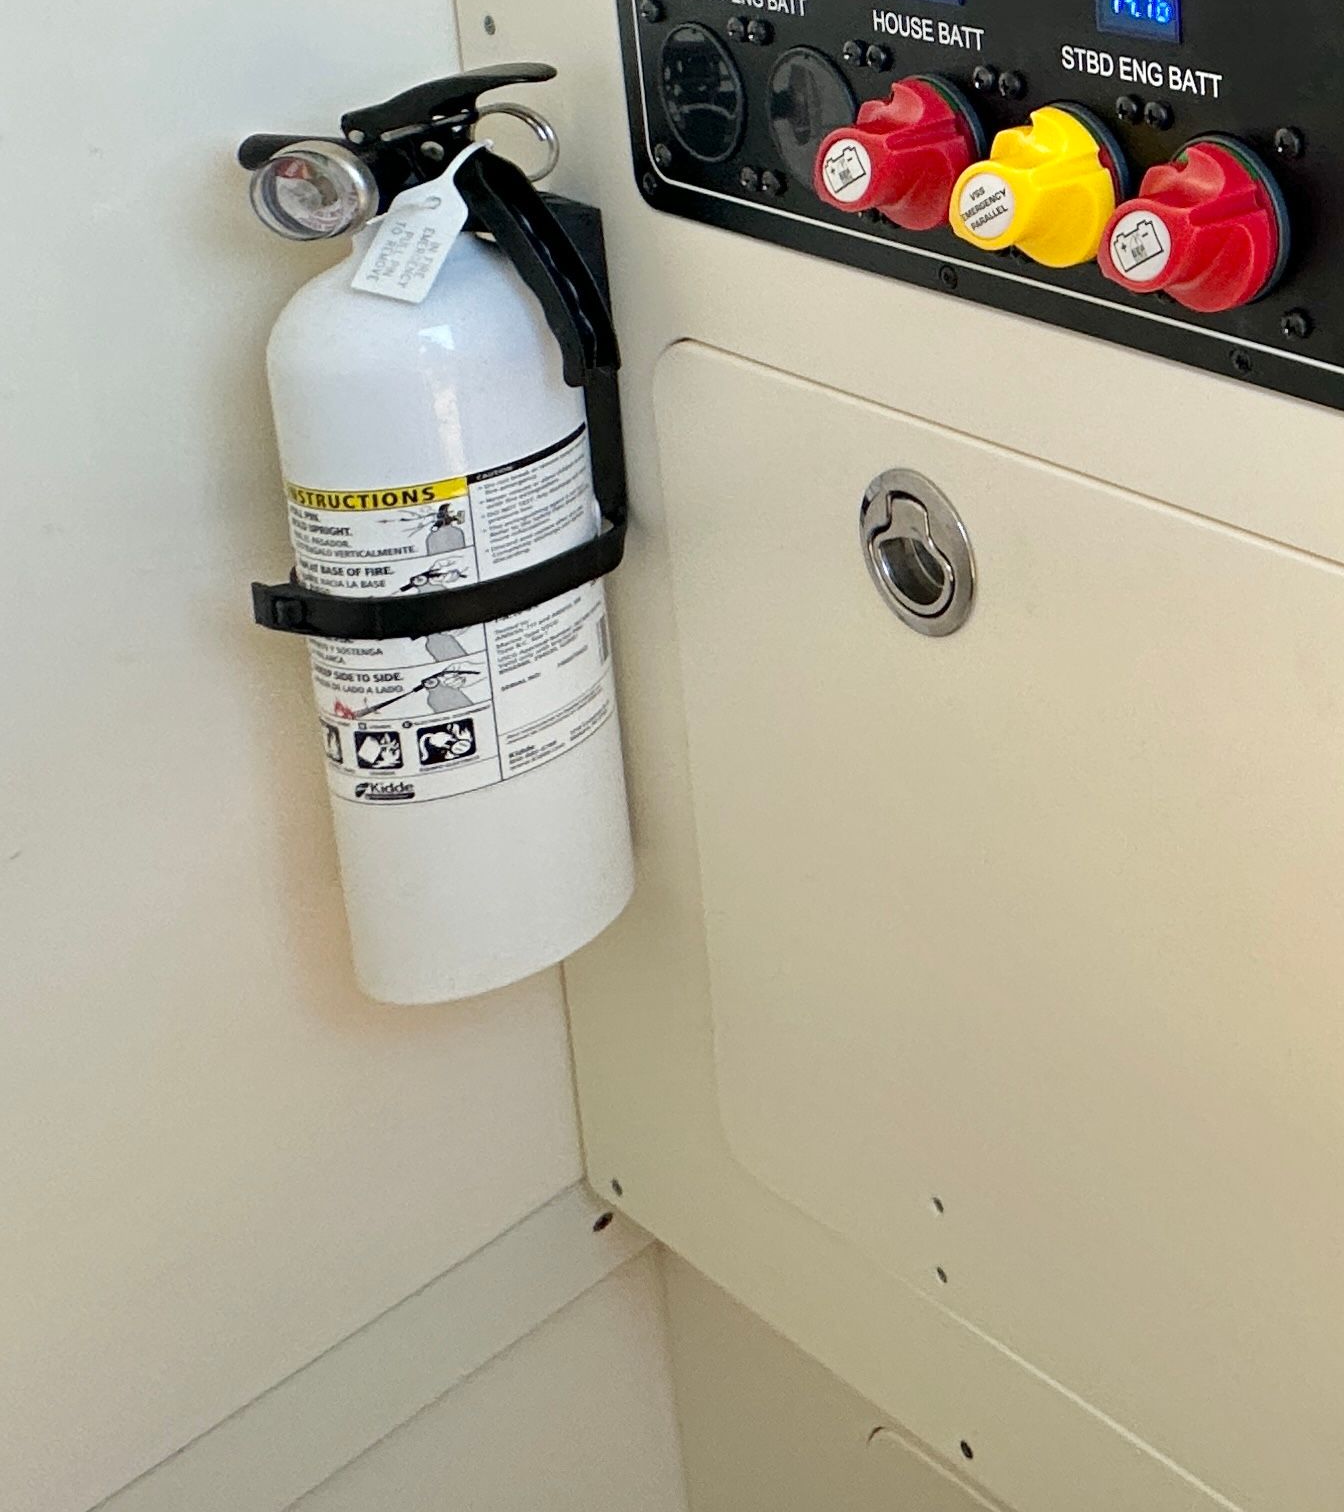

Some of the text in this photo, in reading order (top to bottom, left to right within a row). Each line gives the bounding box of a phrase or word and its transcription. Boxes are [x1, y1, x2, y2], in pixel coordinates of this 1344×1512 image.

[873, 9, 984, 51] HOUSE BATT
[1062, 45, 1222, 98] STBD ENG BATT
